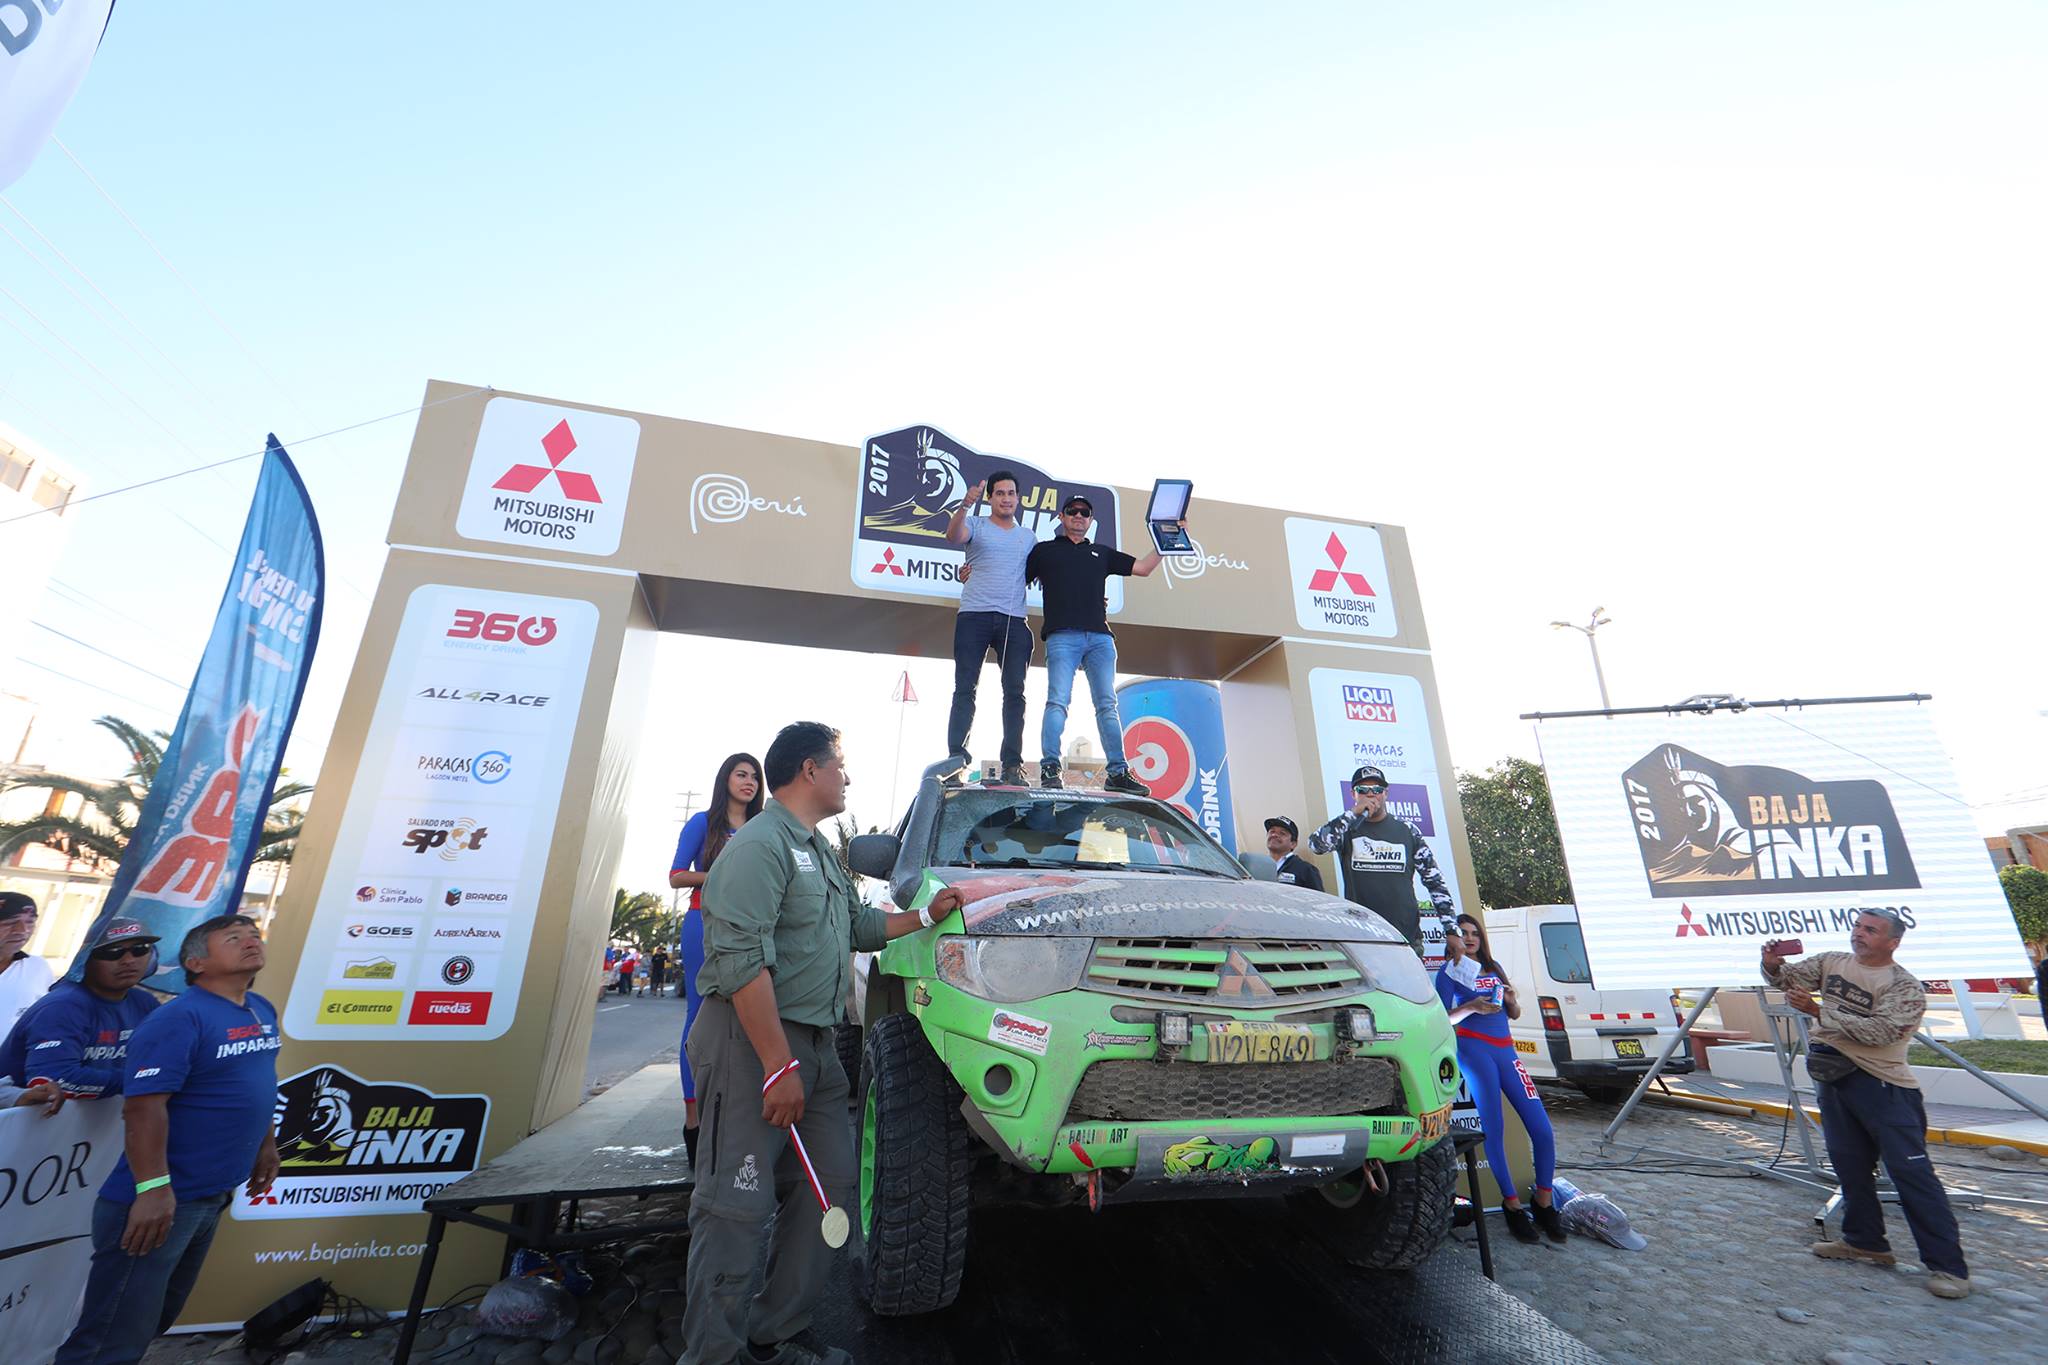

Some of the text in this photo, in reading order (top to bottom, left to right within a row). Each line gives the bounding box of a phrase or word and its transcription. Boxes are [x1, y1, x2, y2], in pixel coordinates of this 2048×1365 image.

[868, 444, 890, 497] 2017
[494, 497, 594, 523] MITSUBISHI
[690, 474, 807, 534] Perú
[504, 518, 576, 540] MOTORS
[1314, 596, 1376, 613] MITSUBISHI
[446, 608, 557, 646] 360
[1324, 612, 1370, 627] MOTORS
[443, 640, 527, 655] ENERGY DRINK
[416, 687, 551, 707] ALL4RACE
[1344, 687, 1391, 704] LIQUI
[1348, 703, 1394, 721] MOLY
[1353, 743, 1404, 757] PARACAS
[418, 756, 504, 777] PARACAS 360
[1627, 778, 1661, 841] 2017
[1749, 794, 1832, 825] BAJA
[408, 818, 455, 828] SALVADO POR
[1752, 825, 1889, 880] INKA
[379, 895, 423, 904] San Pablo
[367, 926, 414, 936] GOES
[1706, 909, 1826, 937] MITSUBISHI
[326, 1003, 393, 1014] El Comercio
[428, 1002, 472, 1014] ruedas
[363, 1106, 435, 1128] BAJA
[346, 1128, 465, 1166] INKA
[280, 1182, 453, 1206] MITSUBISHI MOTOR
